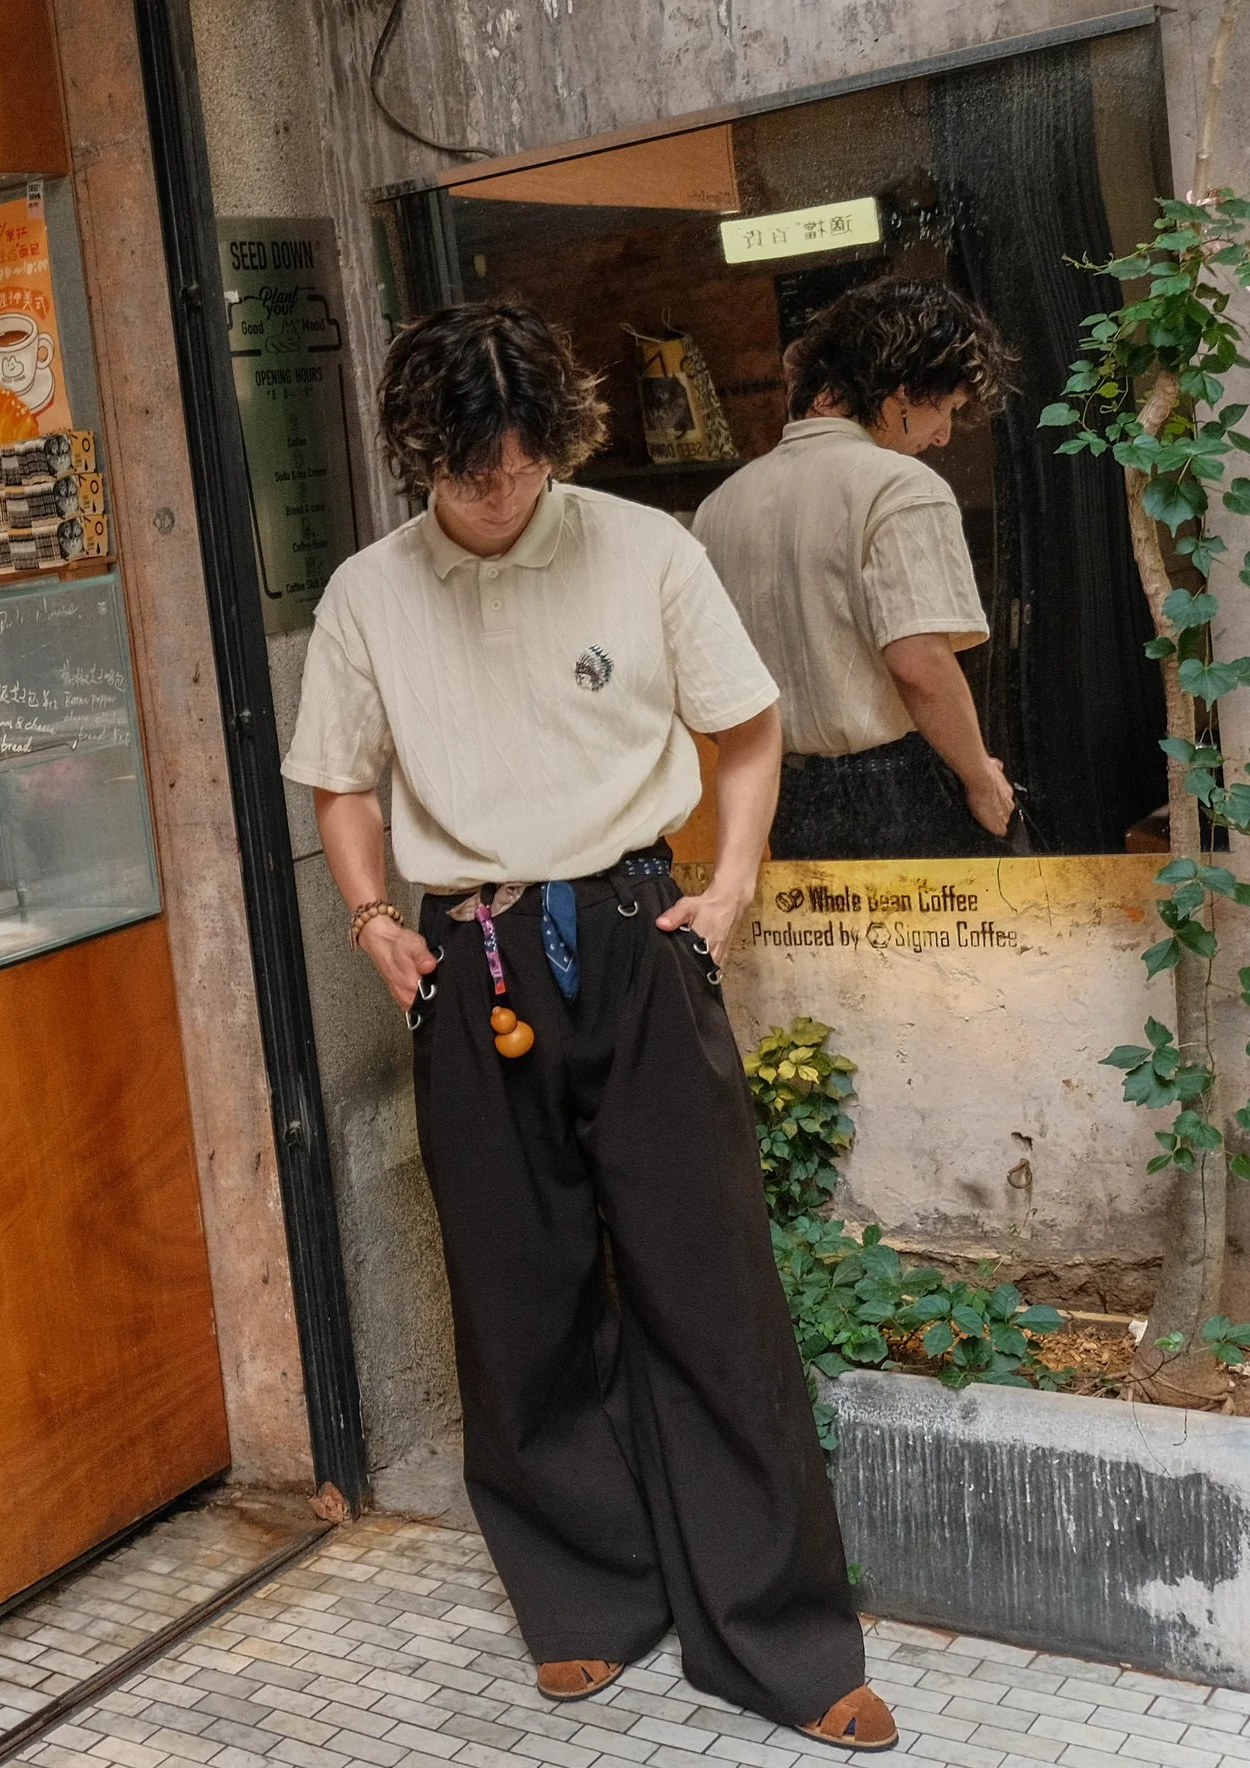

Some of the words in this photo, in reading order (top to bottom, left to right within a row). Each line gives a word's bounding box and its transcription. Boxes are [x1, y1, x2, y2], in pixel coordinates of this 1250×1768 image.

[230, 240, 268, 271] SEED
[271, 240, 315, 270] DOWN
[259, 284, 302, 308] Plant
[266, 303, 297, 321] your
[241, 320, 265, 335] Good
[301, 317, 326, 332] Mood
[255, 367, 292, 387] OPENING
[294, 366, 323, 384] HOURS
[15, 716, 24, 729] &
[2, 734, 33, 753] bread
[809, 885, 862, 913] Whole
[917, 885, 979, 913] Coffee
[751, 921, 834, 948] Produced
[840, 921, 860, 951] by
[894, 921, 950, 953] Sigma
[956, 921, 1018, 948] Coffee
